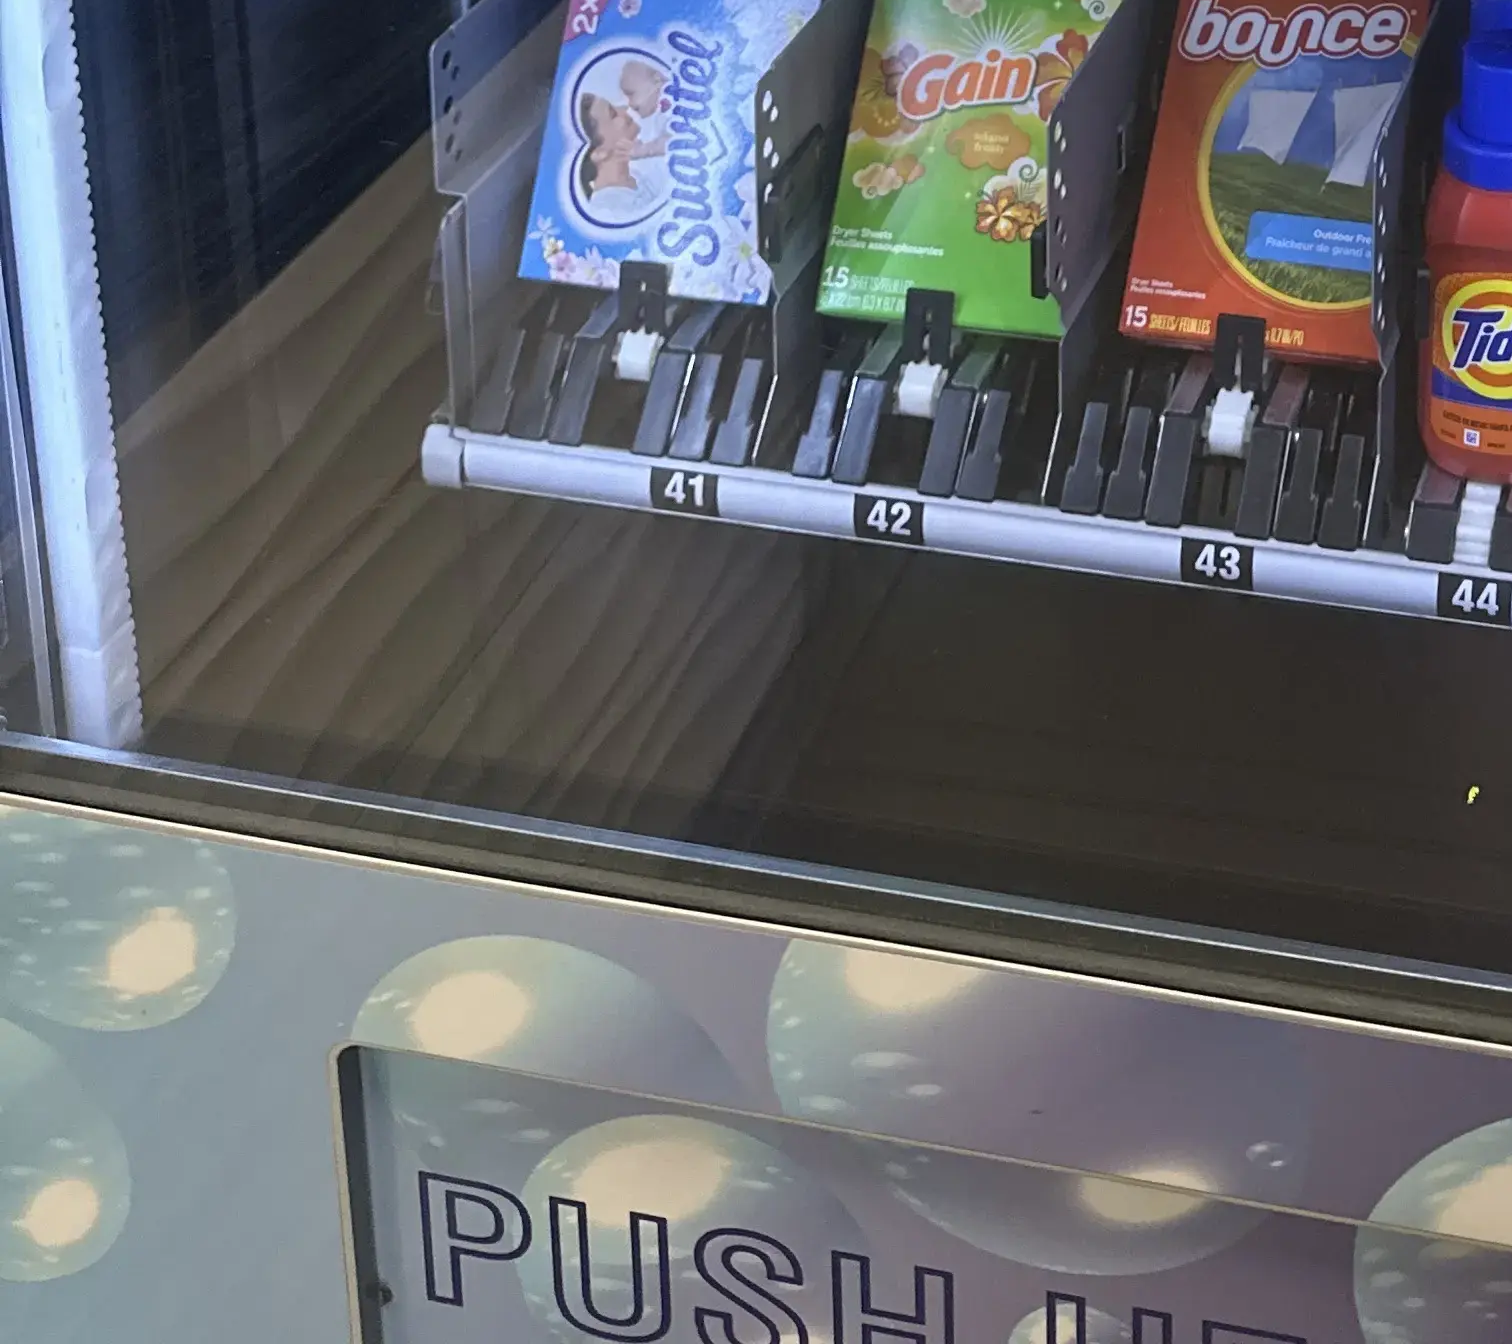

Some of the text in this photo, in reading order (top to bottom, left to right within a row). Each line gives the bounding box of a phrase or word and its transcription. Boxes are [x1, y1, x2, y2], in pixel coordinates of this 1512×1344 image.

[899, 48, 1037, 120] Gain
[657, 30, 724, 267] Suavitel
[1312, 228, 1354, 243] Outdoor
[1315, 242, 1364, 258] de grand
[822, 265, 850, 289] 15
[1124, 304, 1149, 328] 15
[664, 471, 706, 507] 41
[866, 500, 912, 538] 42
[1195, 544, 1242, 581] 43
[1451, 580, 1500, 615] 44
[418, 1170, 956, 1344] PUSH
